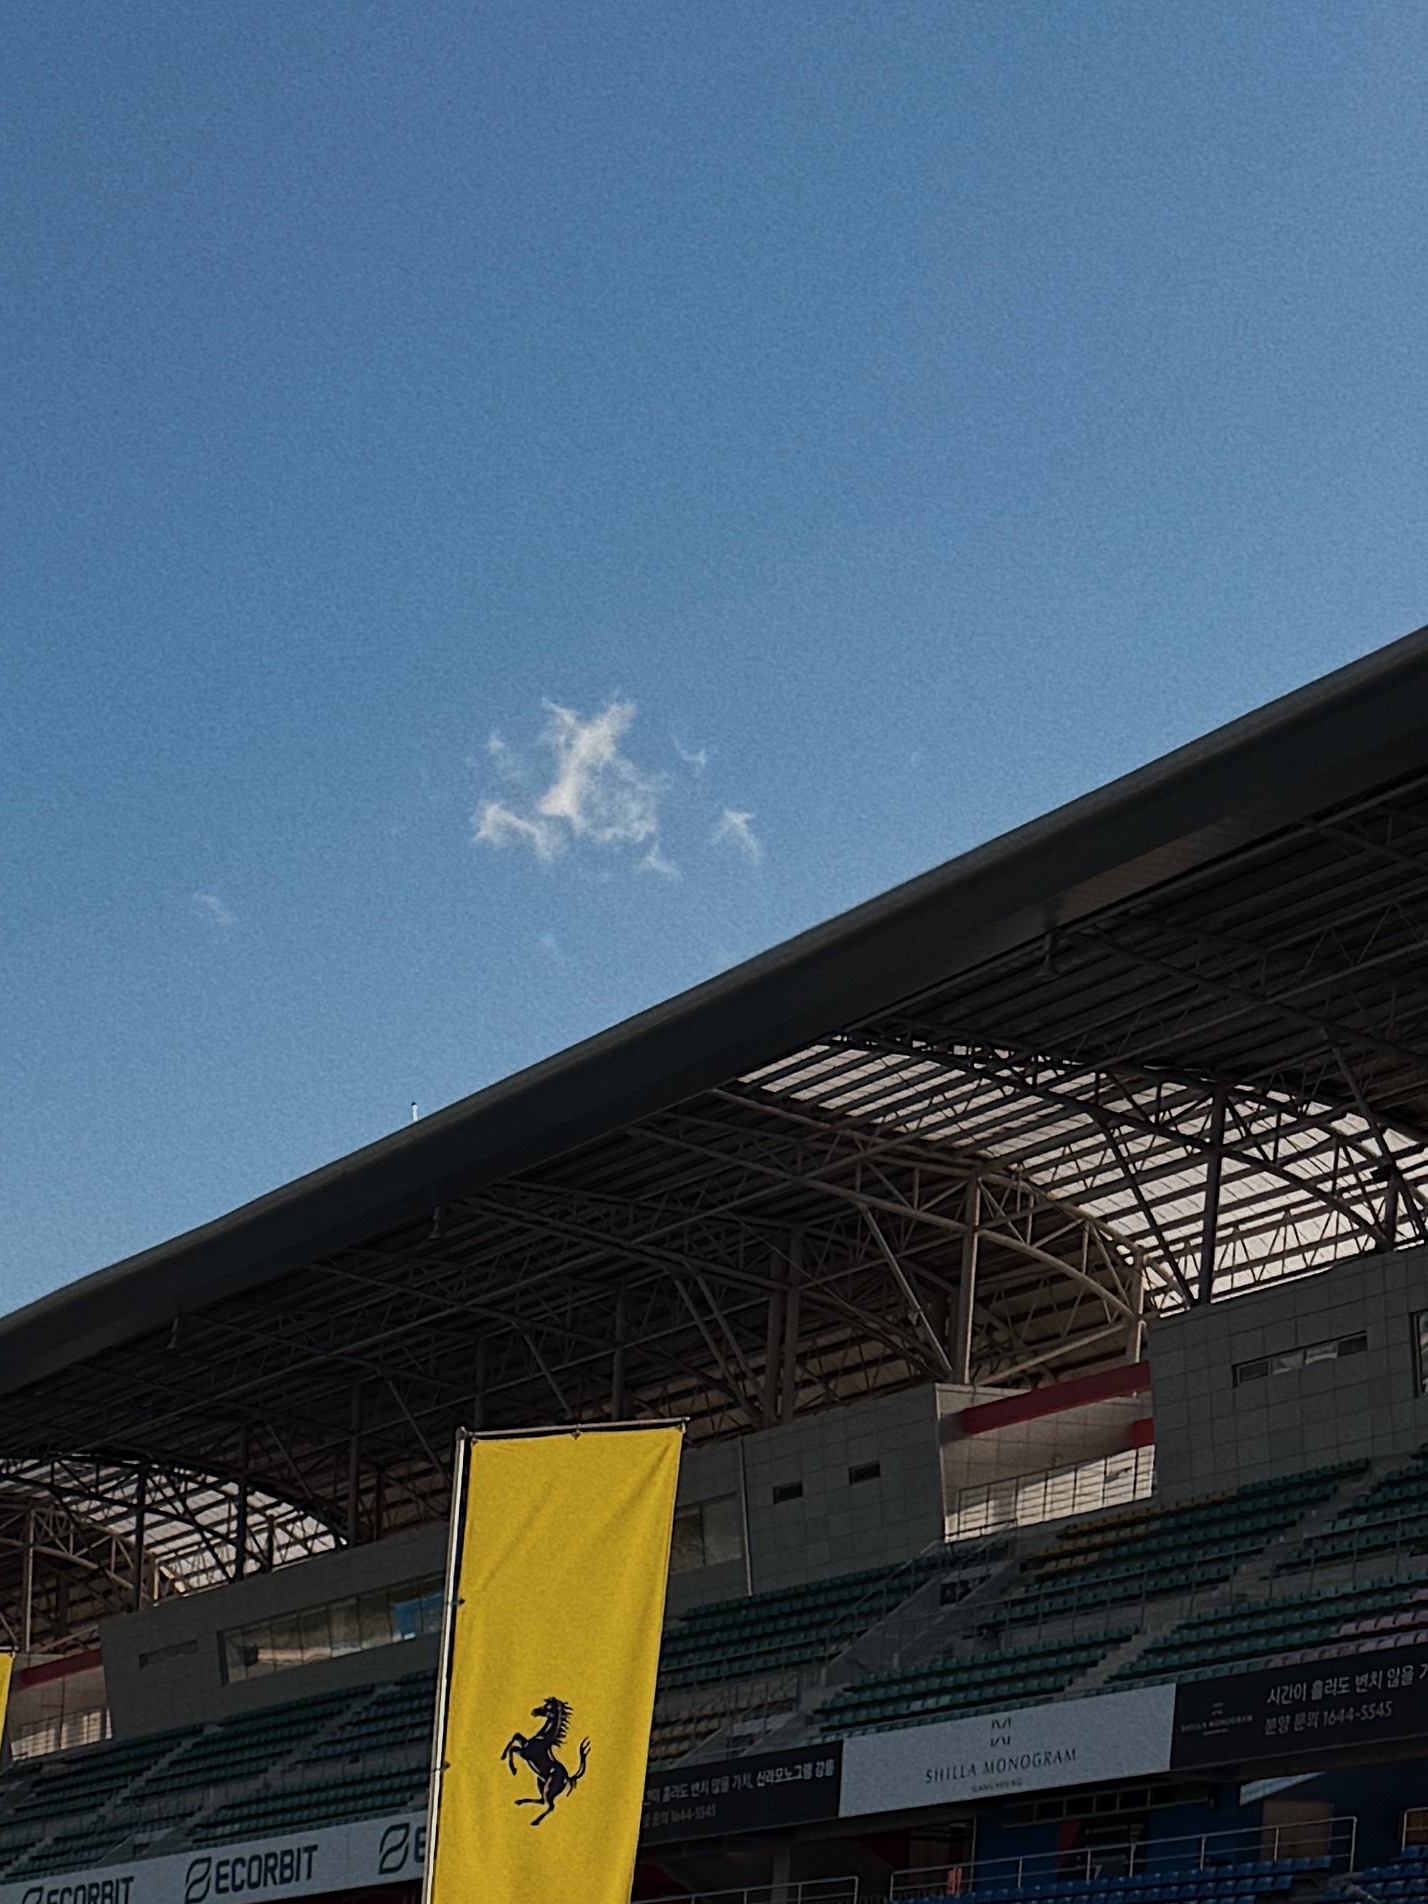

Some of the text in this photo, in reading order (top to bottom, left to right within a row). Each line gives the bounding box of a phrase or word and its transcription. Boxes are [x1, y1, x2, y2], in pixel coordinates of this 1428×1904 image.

[1266, 1682, 1307, 1706] 시간이
[1311, 1675, 1351, 1700] 흘러도
[1355, 1670, 1383, 1693] 변치
[1264, 1714, 1291, 1736] 분양
[1322, 1701, 1394, 1726] 1644-5545
[924, 1749, 1077, 1785] SHILLA MONOGRAM
[215, 1844, 318, 1895] ECORBIT
